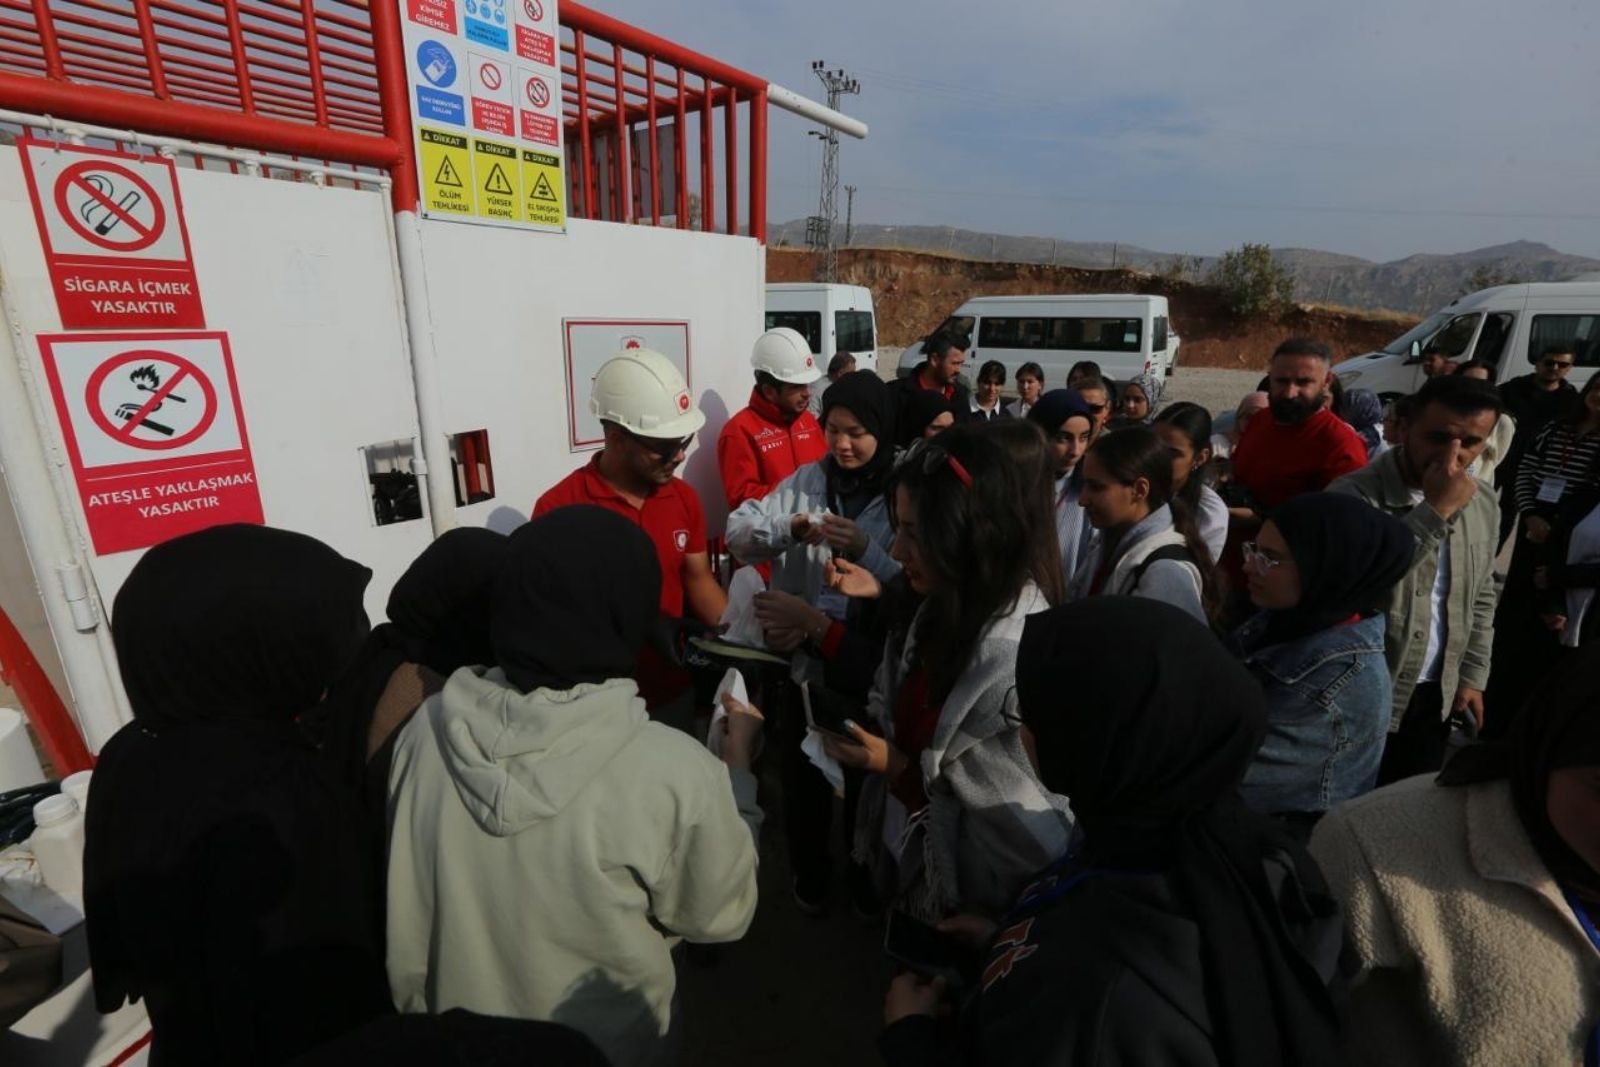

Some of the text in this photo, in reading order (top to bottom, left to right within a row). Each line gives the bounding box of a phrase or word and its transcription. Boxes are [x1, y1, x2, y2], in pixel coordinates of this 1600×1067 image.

[432, 132, 461, 146] DİKKAT
[485, 144, 510, 156] DİKKAT
[439, 189, 462, 200] ÖLÜM
[432, 200, 469, 212] TEHLİKESİ
[487, 196, 512, 207] YÜKSEK
[488, 208, 513, 219] BASINÇ
[63, 276, 191, 296] SİGARA İÇMEK
[90, 299, 177, 314] YASAKTIR
[88, 472, 254, 508] ATEŞLE YAKLAŞMAK
[138, 495, 220, 519] YASAKTIR
